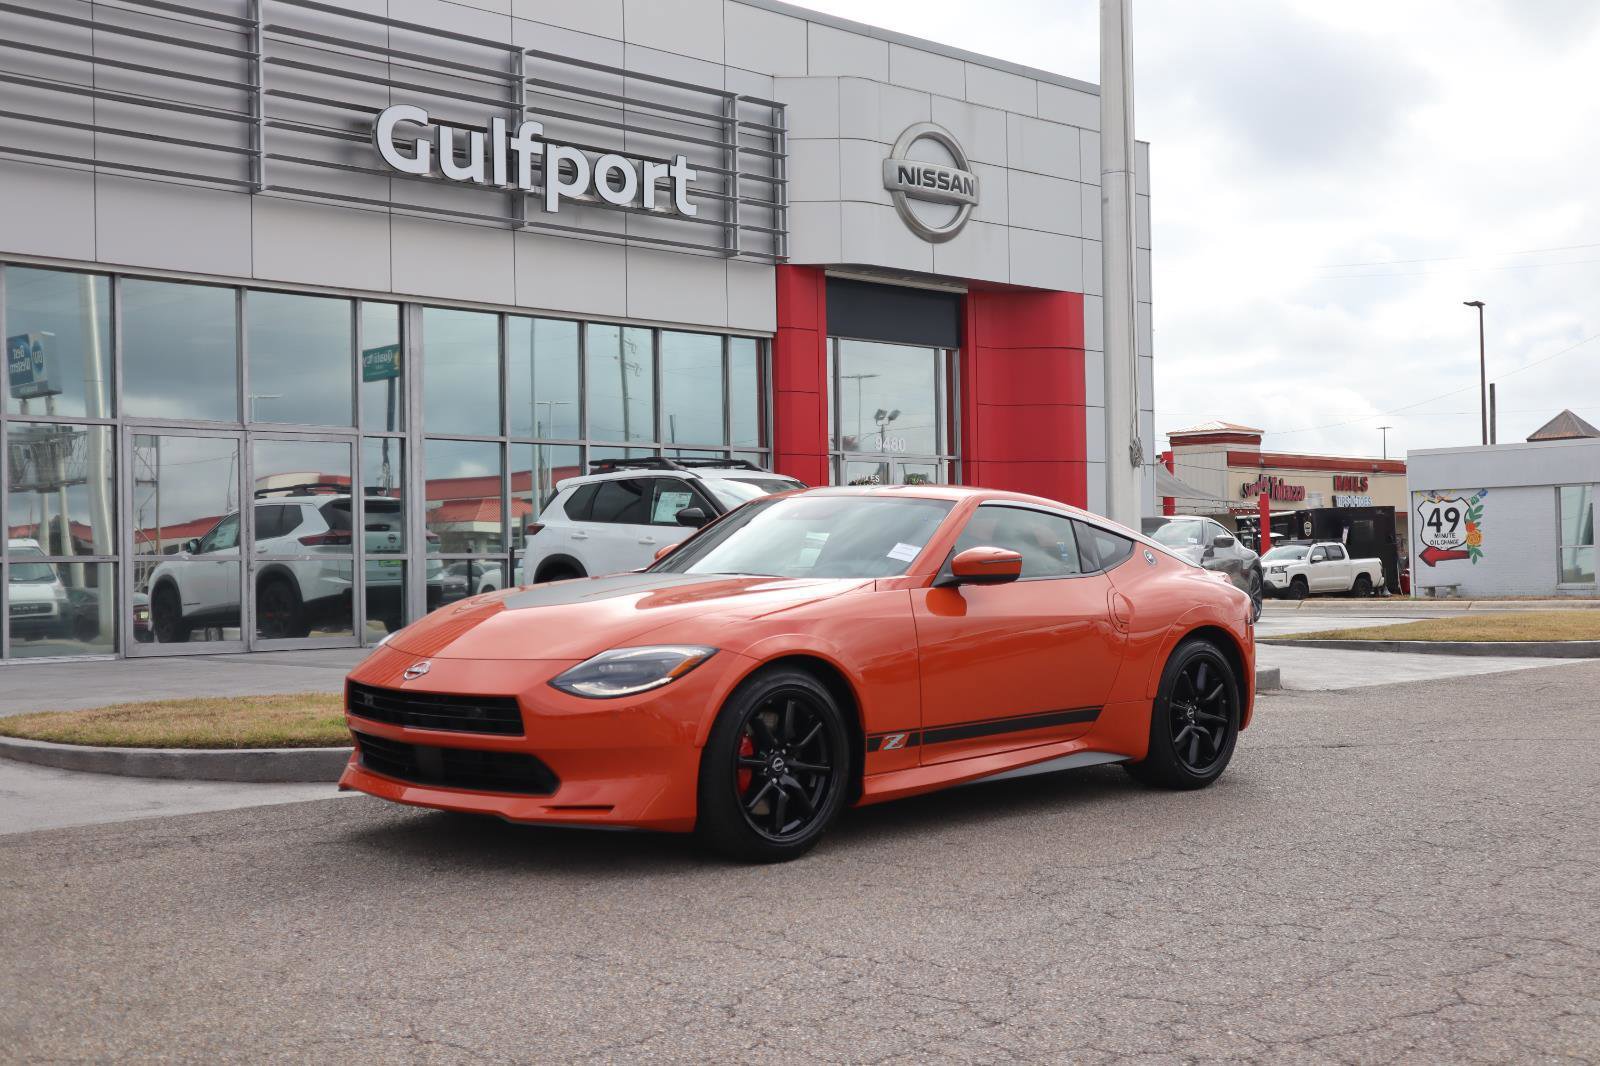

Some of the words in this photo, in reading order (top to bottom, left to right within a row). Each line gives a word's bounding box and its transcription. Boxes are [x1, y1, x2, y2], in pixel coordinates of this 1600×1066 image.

[373, 103, 697, 216] Gulfport
[898, 164, 975, 197] NISSAN
[1333, 476, 1368, 492] NAILS
[1427, 507, 1460, 533] 49
[883, 734, 905, 750] Z
